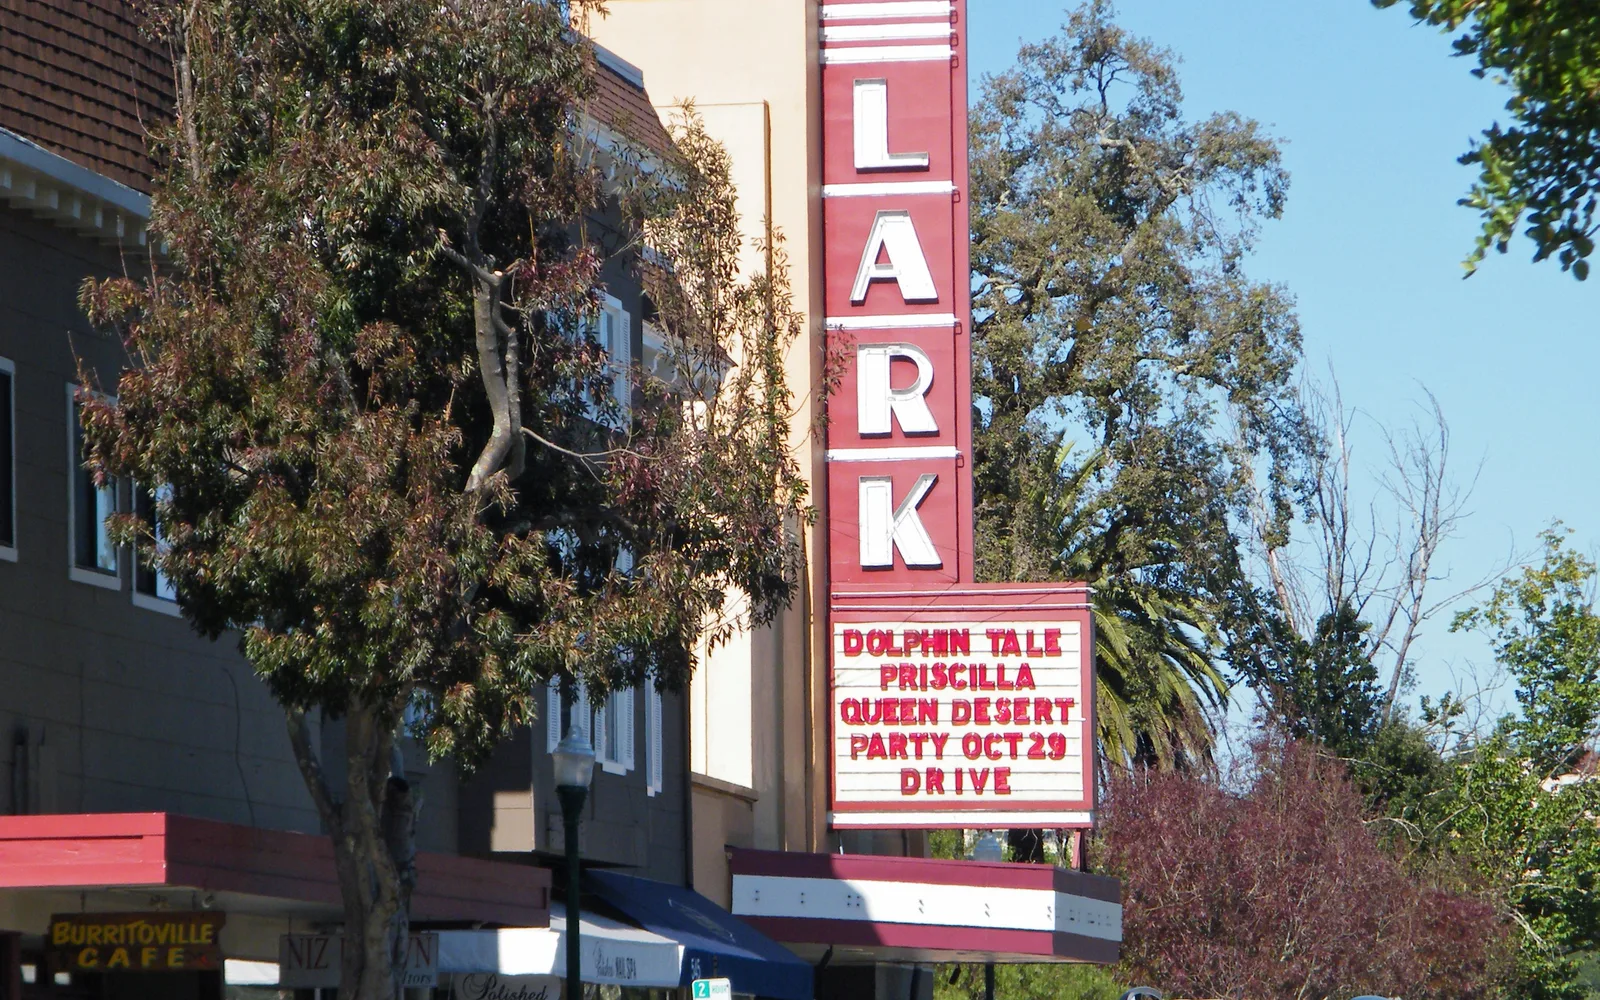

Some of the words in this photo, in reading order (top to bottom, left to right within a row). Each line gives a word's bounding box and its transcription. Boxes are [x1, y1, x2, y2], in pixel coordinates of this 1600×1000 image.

[849, 78, 943, 569] LARK
[843, 628, 970, 657] DOLPHIN
[985, 628, 1062, 658] TALE
[880, 662, 1036, 691] PRISCILLA
[840, 697, 939, 726] QUEEN
[951, 697, 1075, 726] DESERT
[850, 732, 950, 760] PARTY
[900, 767, 1012, 795] DRIVE
[52, 920, 215, 945] BURRITOVILLE
[77, 946, 185, 969] CAFE
[287, 936, 331, 970] NIZ
[462, 973, 549, 1000] Polished
[698, 982, 706, 997] 2
